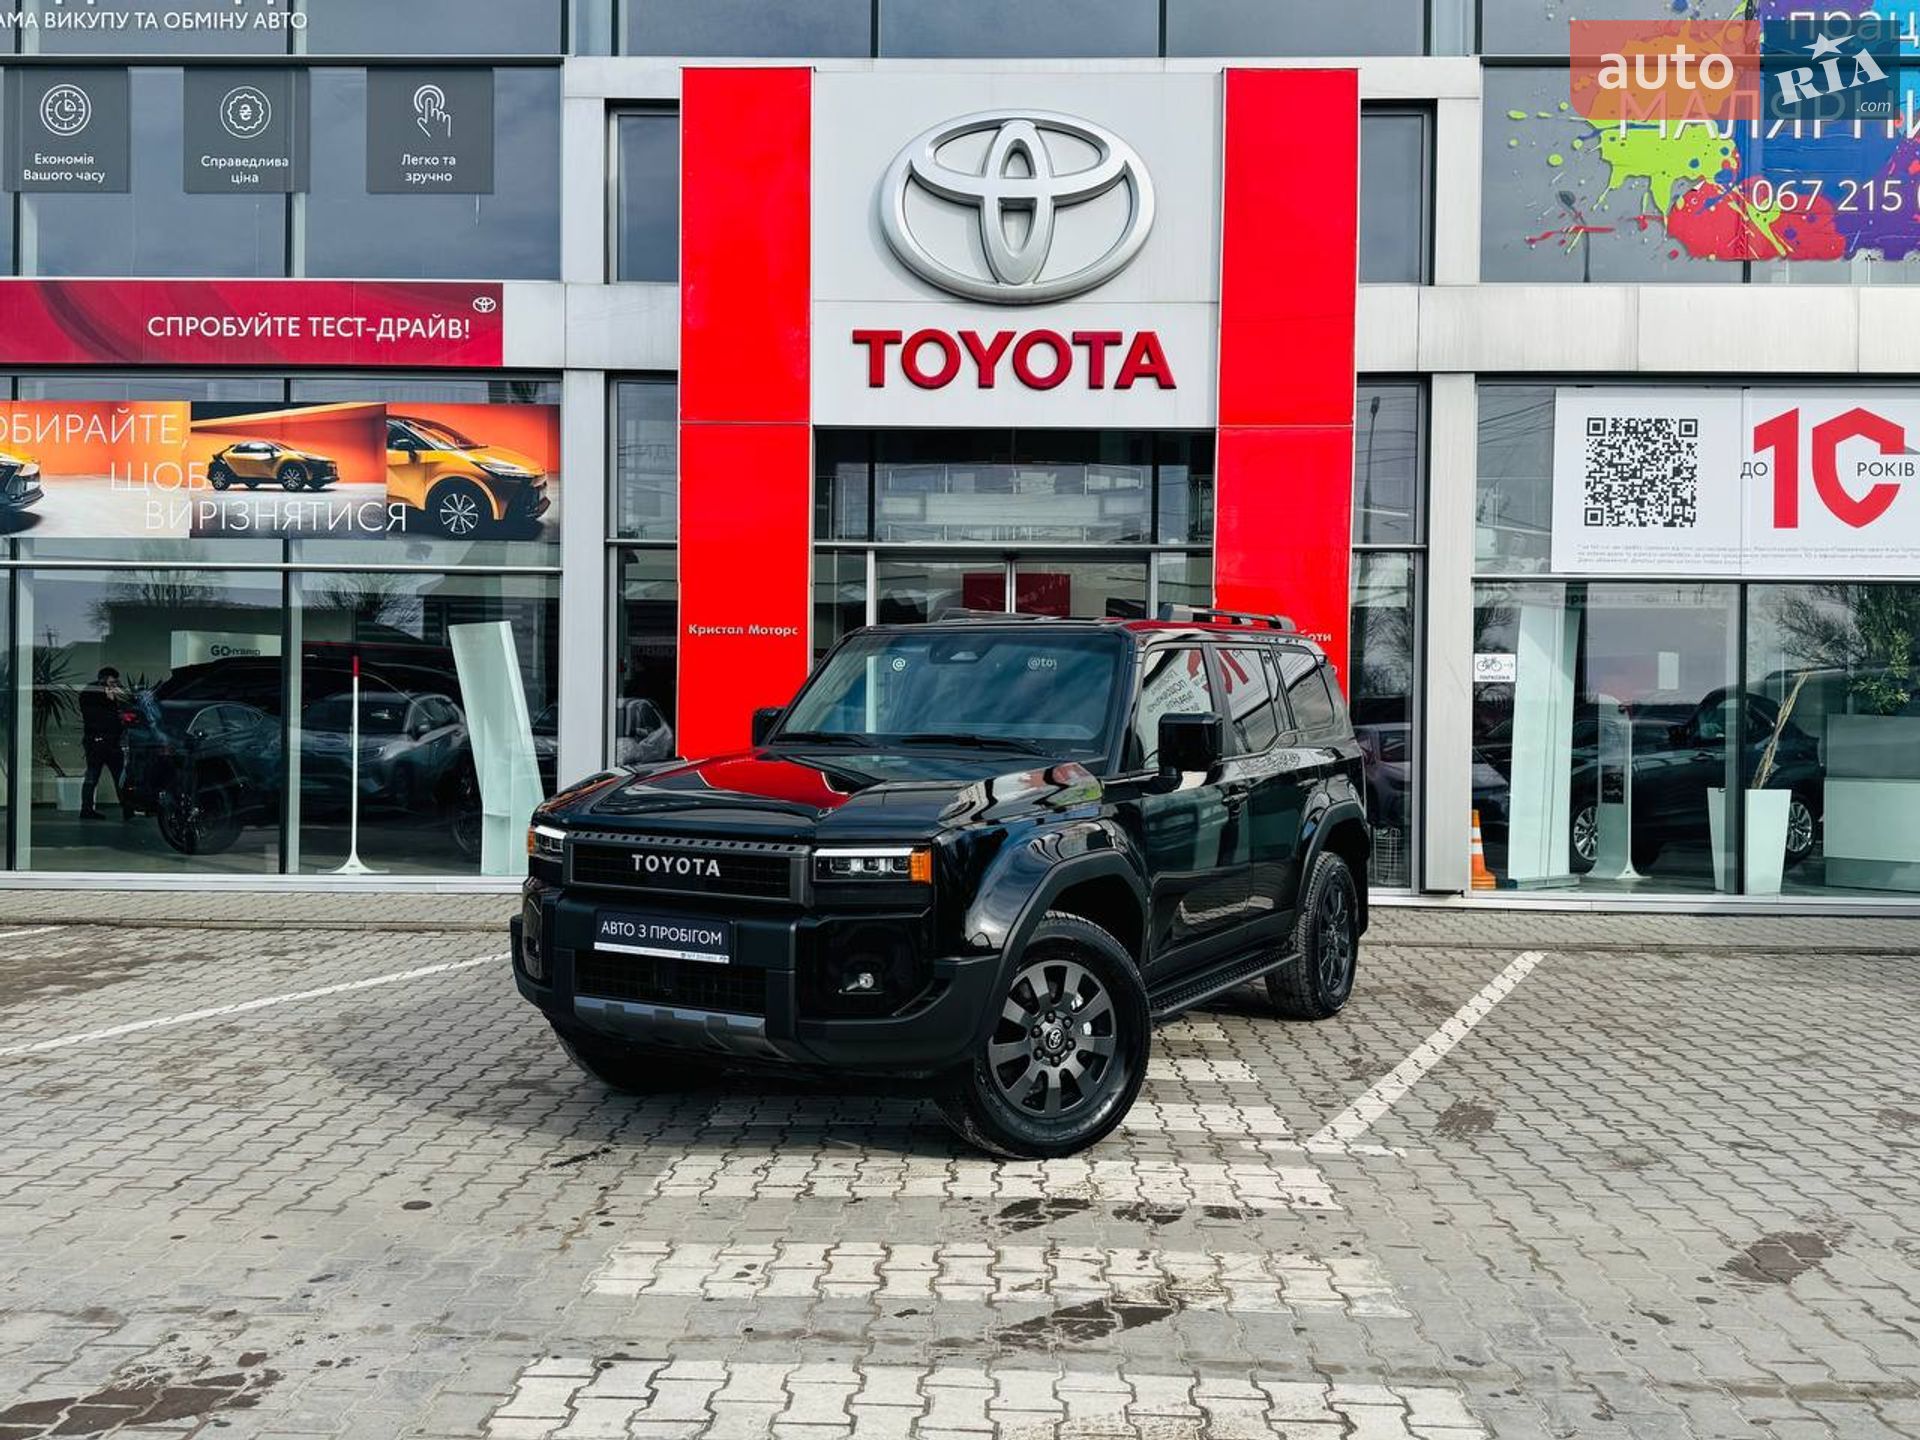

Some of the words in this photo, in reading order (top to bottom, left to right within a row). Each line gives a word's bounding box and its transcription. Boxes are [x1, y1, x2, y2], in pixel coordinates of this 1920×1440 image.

[44, 12, 129, 29] ВИКУПУ
[134, 13, 158, 28] ТА
[163, 12, 248, 29] ОБМІНУ
[253, 12, 308, 29] АВТО
[34, 152, 95, 166] Економія
[200, 154, 289, 170] Справедлива
[401, 153, 440, 168] Легко
[442, 155, 456, 166] та
[23, 169, 73, 182] Вашого
[76, 171, 106, 184] часу
[230, 170, 260, 184] ціна
[404, 171, 453, 183] зручно
[1752, 180, 1824, 212] 067
[1837, 179, 1903, 212] 215
[147, 312, 301, 338] СПРОБУЙТЕ
[308, 313, 471, 343] ТЕСТ-ДРАЙВ!
[852, 328, 1177, 391] TOYOTA
[0, 407, 190, 450] БИРАЙТЕ,
[110, 461, 207, 497] ЩОБ
[1740, 461, 1769, 479] ДО
[1857, 461, 1915, 477] РОКІВ
[145, 500, 407, 532] ВИРІЗНЯТИСЯ
[688, 624, 744, 637] Кристал
[748, 624, 799, 638] Моторс
[632, 854, 720, 877] TOYOTA
[600, 920, 636, 938] АВТО
[638, 923, 648, 939] З
[650, 926, 722, 945] ПРОБІГОМ
